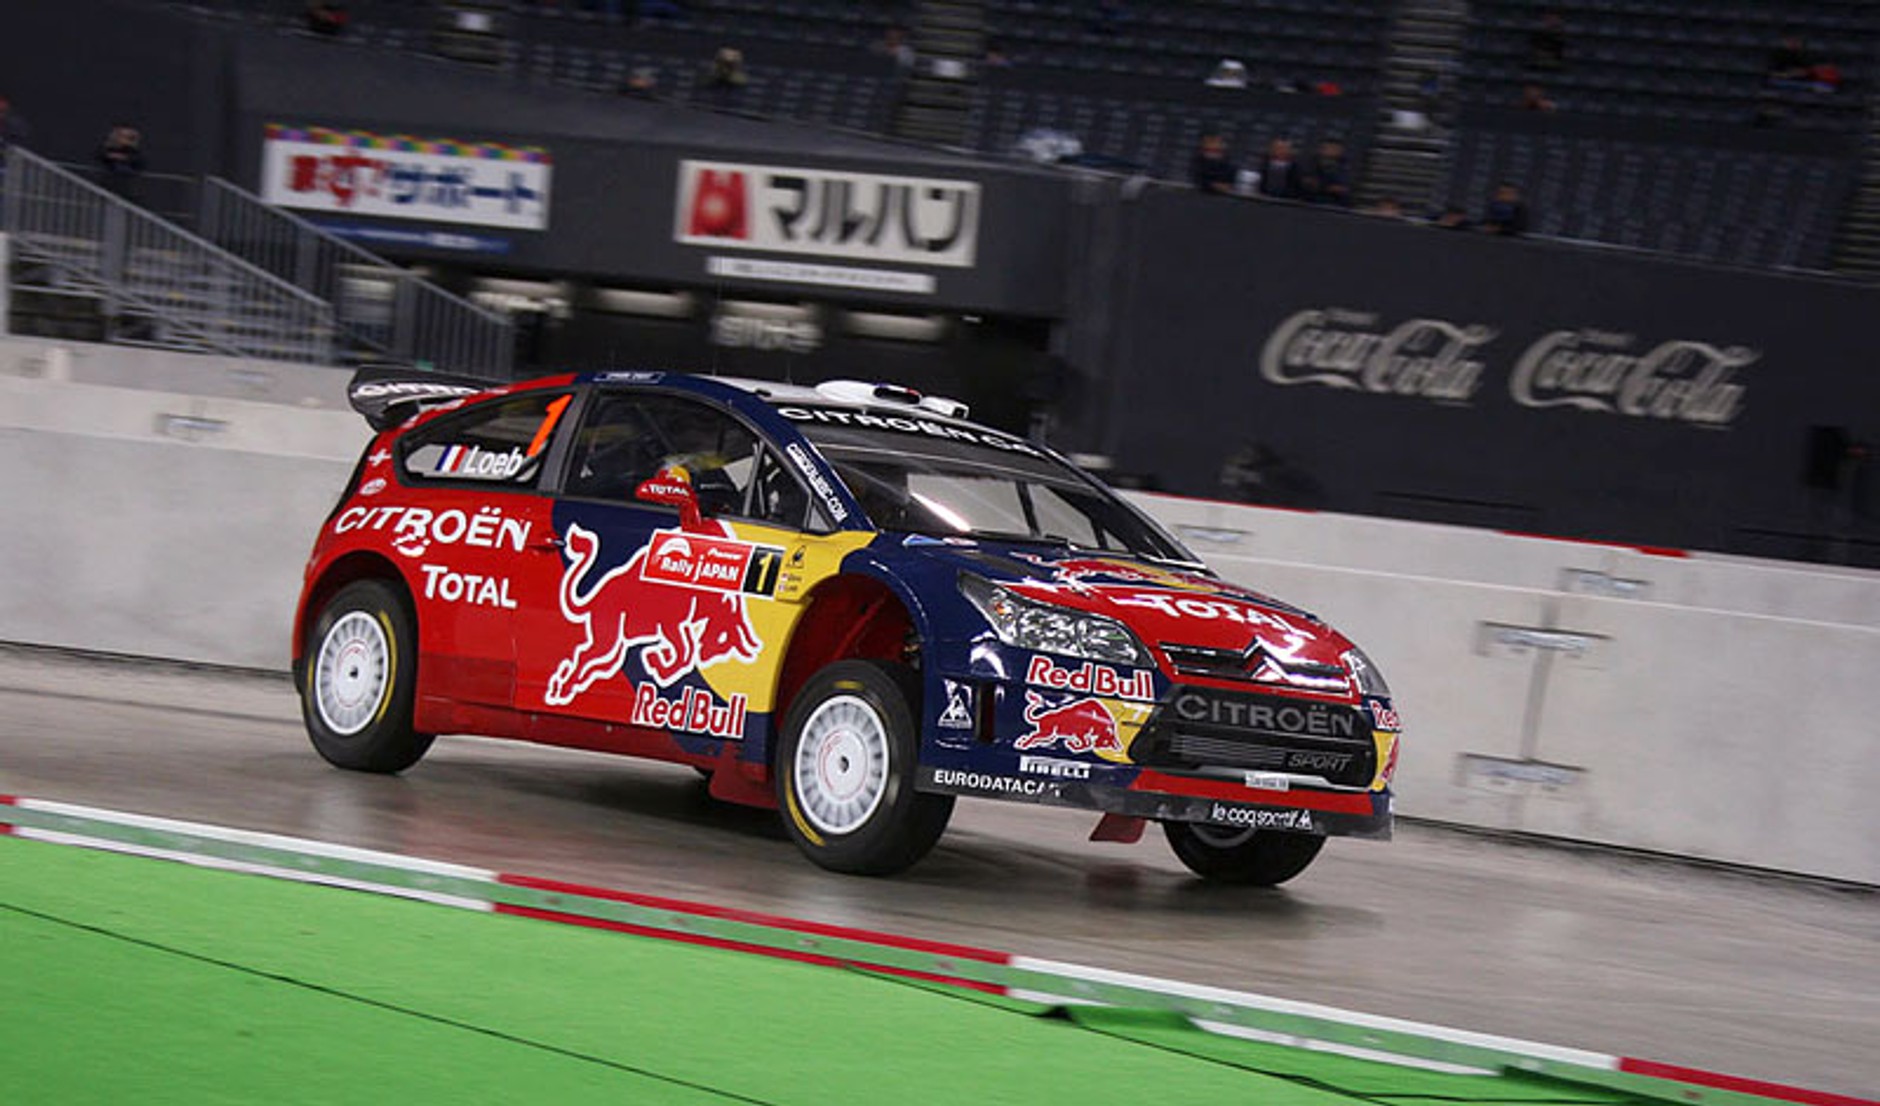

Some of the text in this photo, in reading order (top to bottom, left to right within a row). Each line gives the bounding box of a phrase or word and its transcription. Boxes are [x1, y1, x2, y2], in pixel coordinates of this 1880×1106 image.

[768, 174, 966, 252] マルハン
[526, 394, 572, 457] 1
[463, 445, 525, 475] Loeb
[649, 484, 690, 497] TOTAL
[334, 505, 532, 553] CITROËN
[421, 564, 518, 609] TOTAL
[660, 556, 695, 577] Rally
[758, 552, 773, 592] 1
[1133, 593, 1317, 640] TOTAL
[1027, 655, 1155, 700] Red Bull
[632, 681, 748, 738] Red Bull
[1176, 693, 1354, 736] CITROËN
[1020, 755, 1091, 779] PIRELLI
[1287, 753, 1353, 771] SPORT
[1212, 802, 1226, 821] le
[1227, 807, 1255, 828] coq
